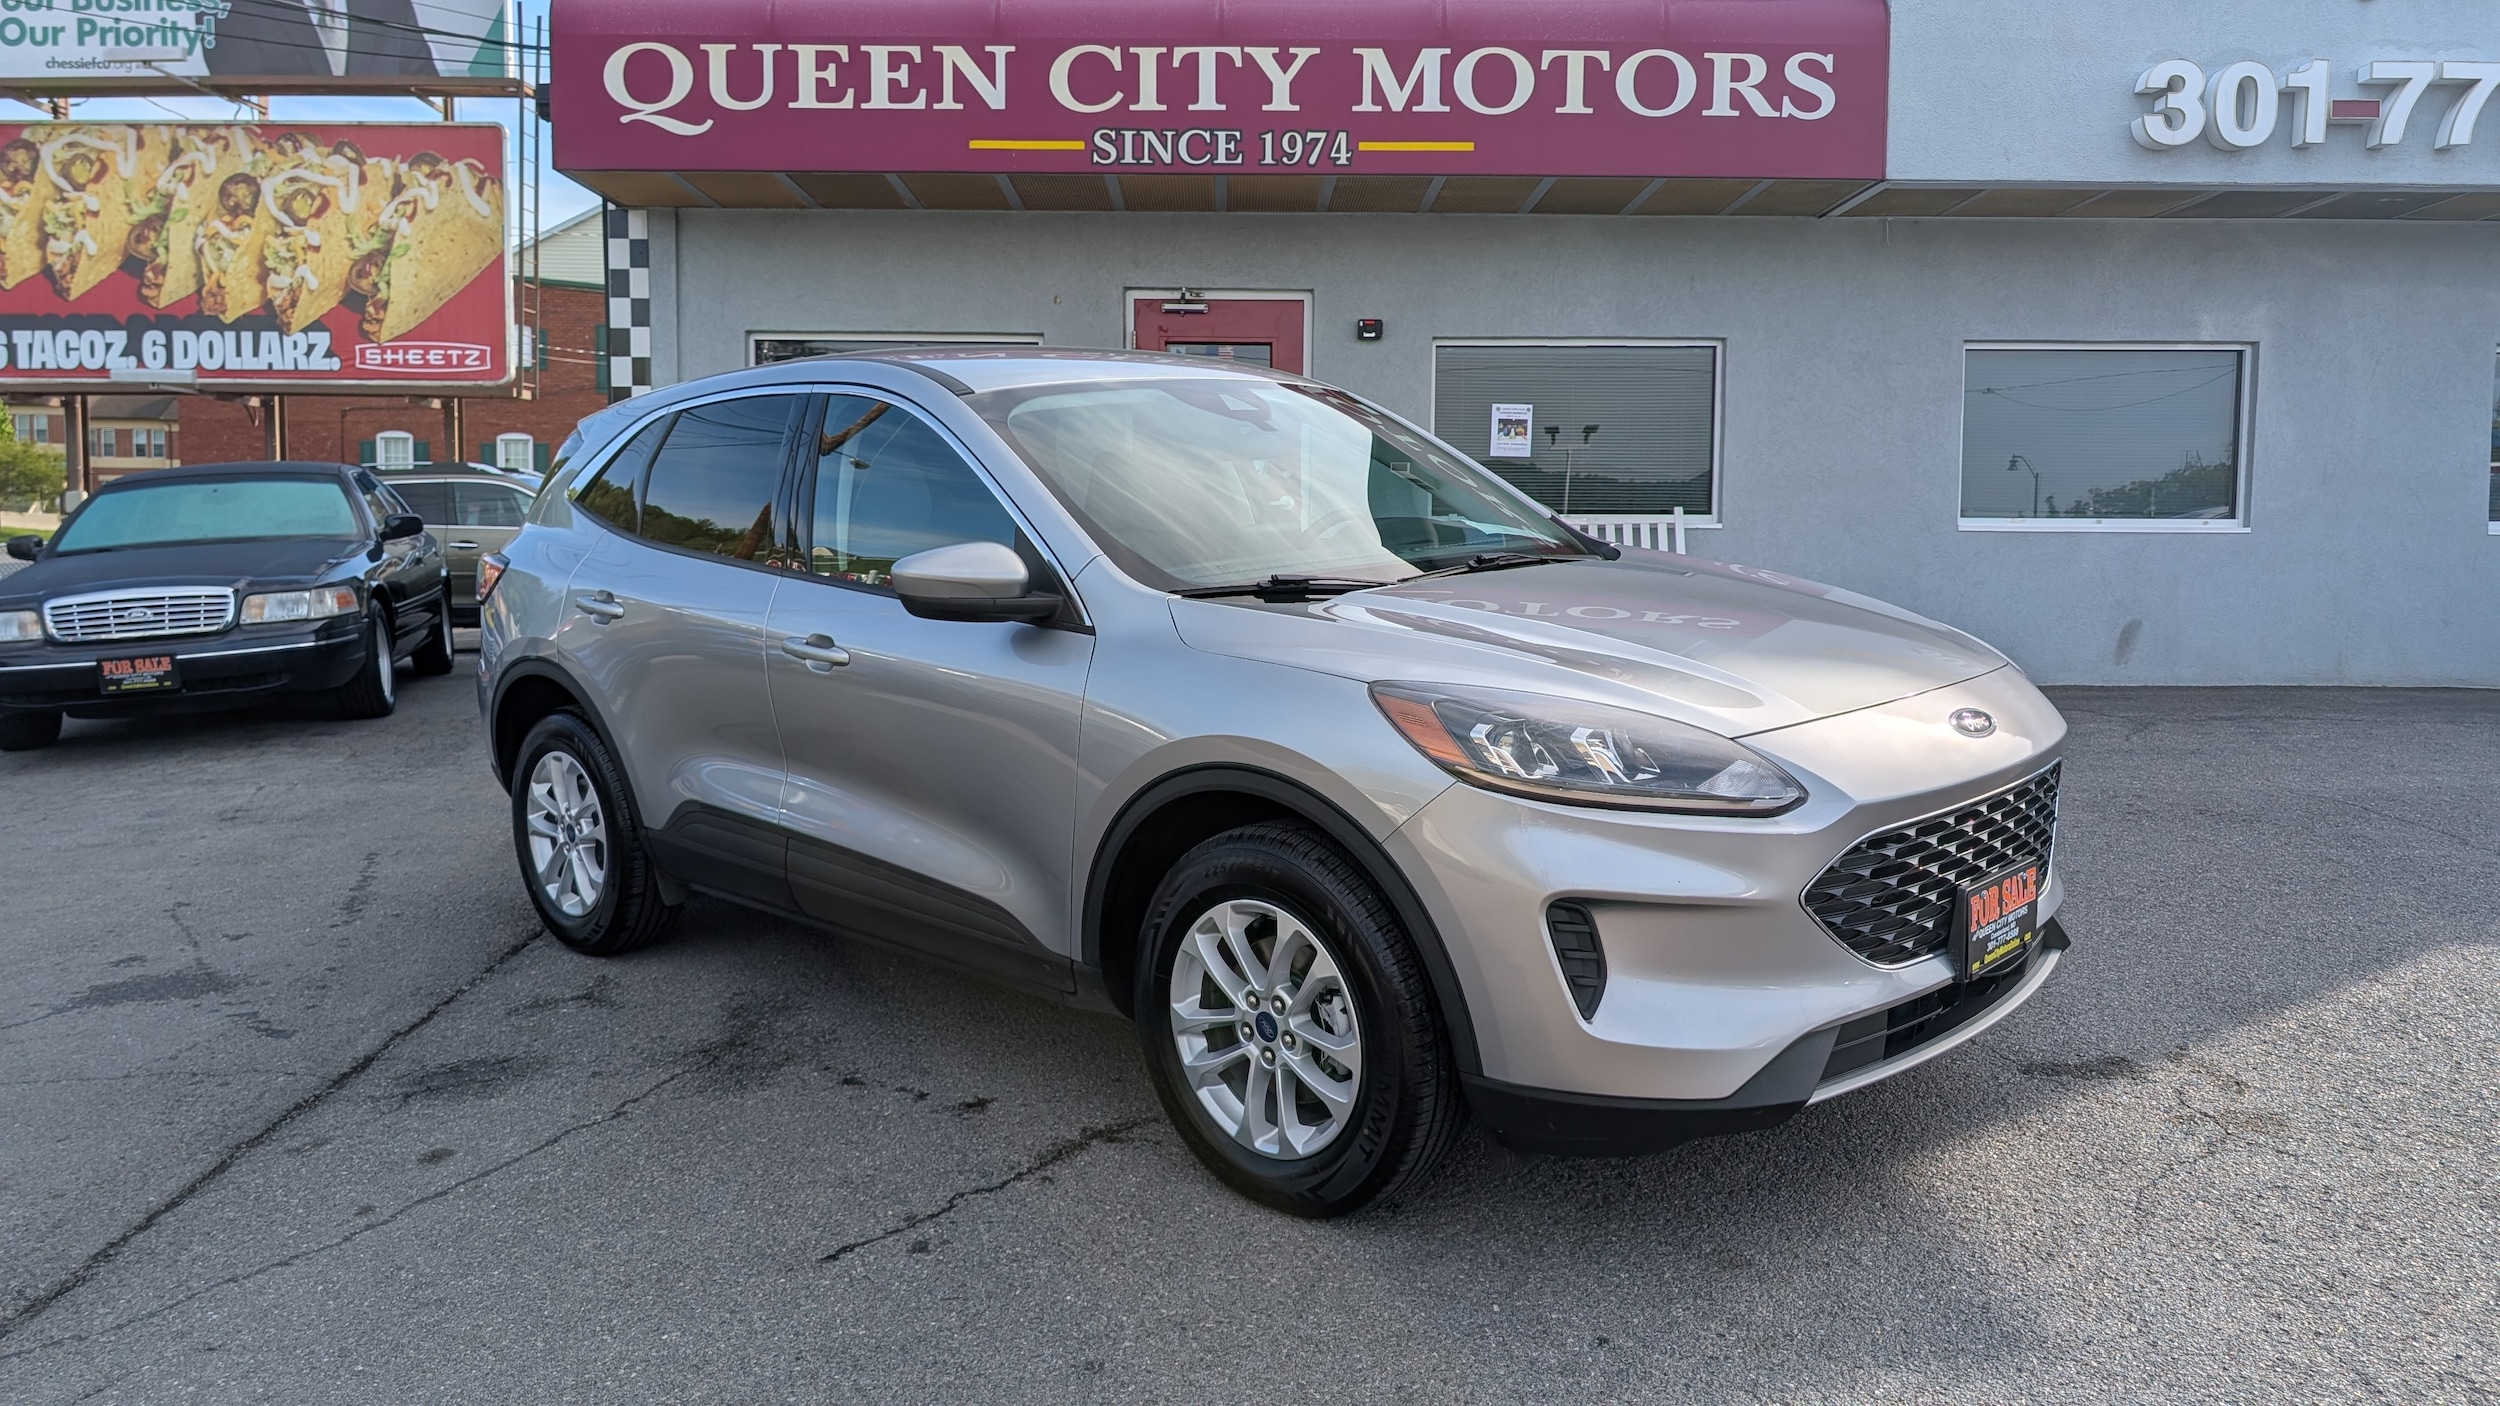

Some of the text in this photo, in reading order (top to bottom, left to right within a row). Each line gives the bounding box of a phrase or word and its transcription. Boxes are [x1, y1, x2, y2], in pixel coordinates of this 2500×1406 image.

[0, 0, 56, 12] our
[0, 16, 217, 57] Our Priority!
[603, 42, 1835, 136] QUEEN CITY MOTORS
[1092, 129, 1352, 165] SINCE 1974
[12, 330, 138, 370] TACOZ.
[142, 330, 167, 370] 6
[172, 331, 342, 371] DOLLARZ.
[365, 349, 481, 365] SHEETZ
[101, 660, 133, 676] FOR
[134, 656, 172, 673] SALE
[1970, 866, 2037, 932] FOR SALE
